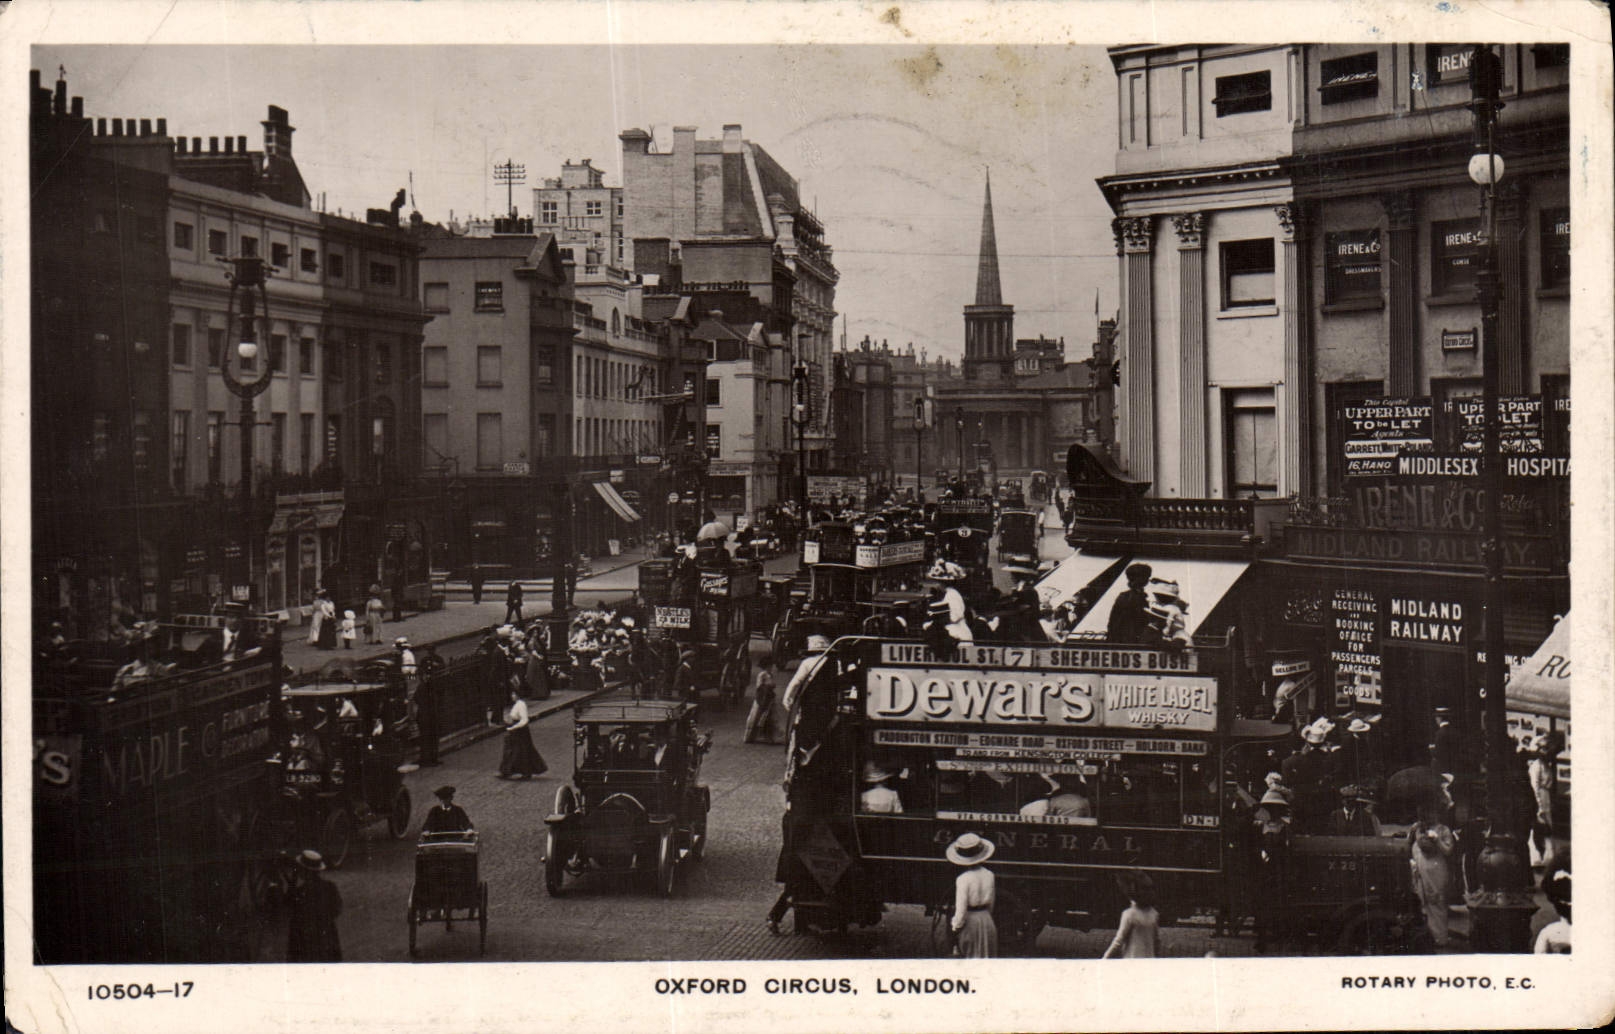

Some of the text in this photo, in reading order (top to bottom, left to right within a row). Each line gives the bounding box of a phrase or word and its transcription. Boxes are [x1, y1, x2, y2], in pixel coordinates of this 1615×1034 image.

[1345, 407, 1392, 419] UPPER
[1394, 406, 1431, 418] PART
[1508, 401, 1542, 412] PART
[1502, 412, 1532, 424] LET
[1353, 420, 1375, 431] TO
[1391, 419, 1421, 430] LET
[1399, 457, 1478, 476] MIDDLESEX
[1355, 484, 1436, 529] IRENE
[1299, 532, 1402, 560] MIDLAND
[1335, 590, 1374, 601] GENERAL
[1332, 600, 1377, 612] RECEIVING
[1391, 598, 1462, 620] MIDLAND
[1336, 618, 1374, 631] BOOKING
[1339, 631, 1373, 642] OFFICE
[1391, 621, 1463, 643] RAILWAY
[1348, 642, 1364, 652] FOR
[889, 645, 1000, 664] LIVEROL ST.
[1010, 651, 1025, 667] 7
[1050, 649, 1189, 670] SHEPHERD'S BUSH
[1331, 651, 1381, 665] PASSENGERS
[1338, 663, 1373, 676] PARCELS
[876, 671, 1095, 723] Dewar's
[1343, 685, 1370, 697] GOODS
[1107, 684, 1213, 714] WHITE LABEL
[1128, 711, 1189, 724] WHISKY
[879, 731, 1206, 753] PADDINGTON STATION EDGWARE ROAD OXFORD STREET HOLBORN BANK
[980, 814, 1037, 823] CORNWALL
[933, 829, 1142, 854] GNERAL
